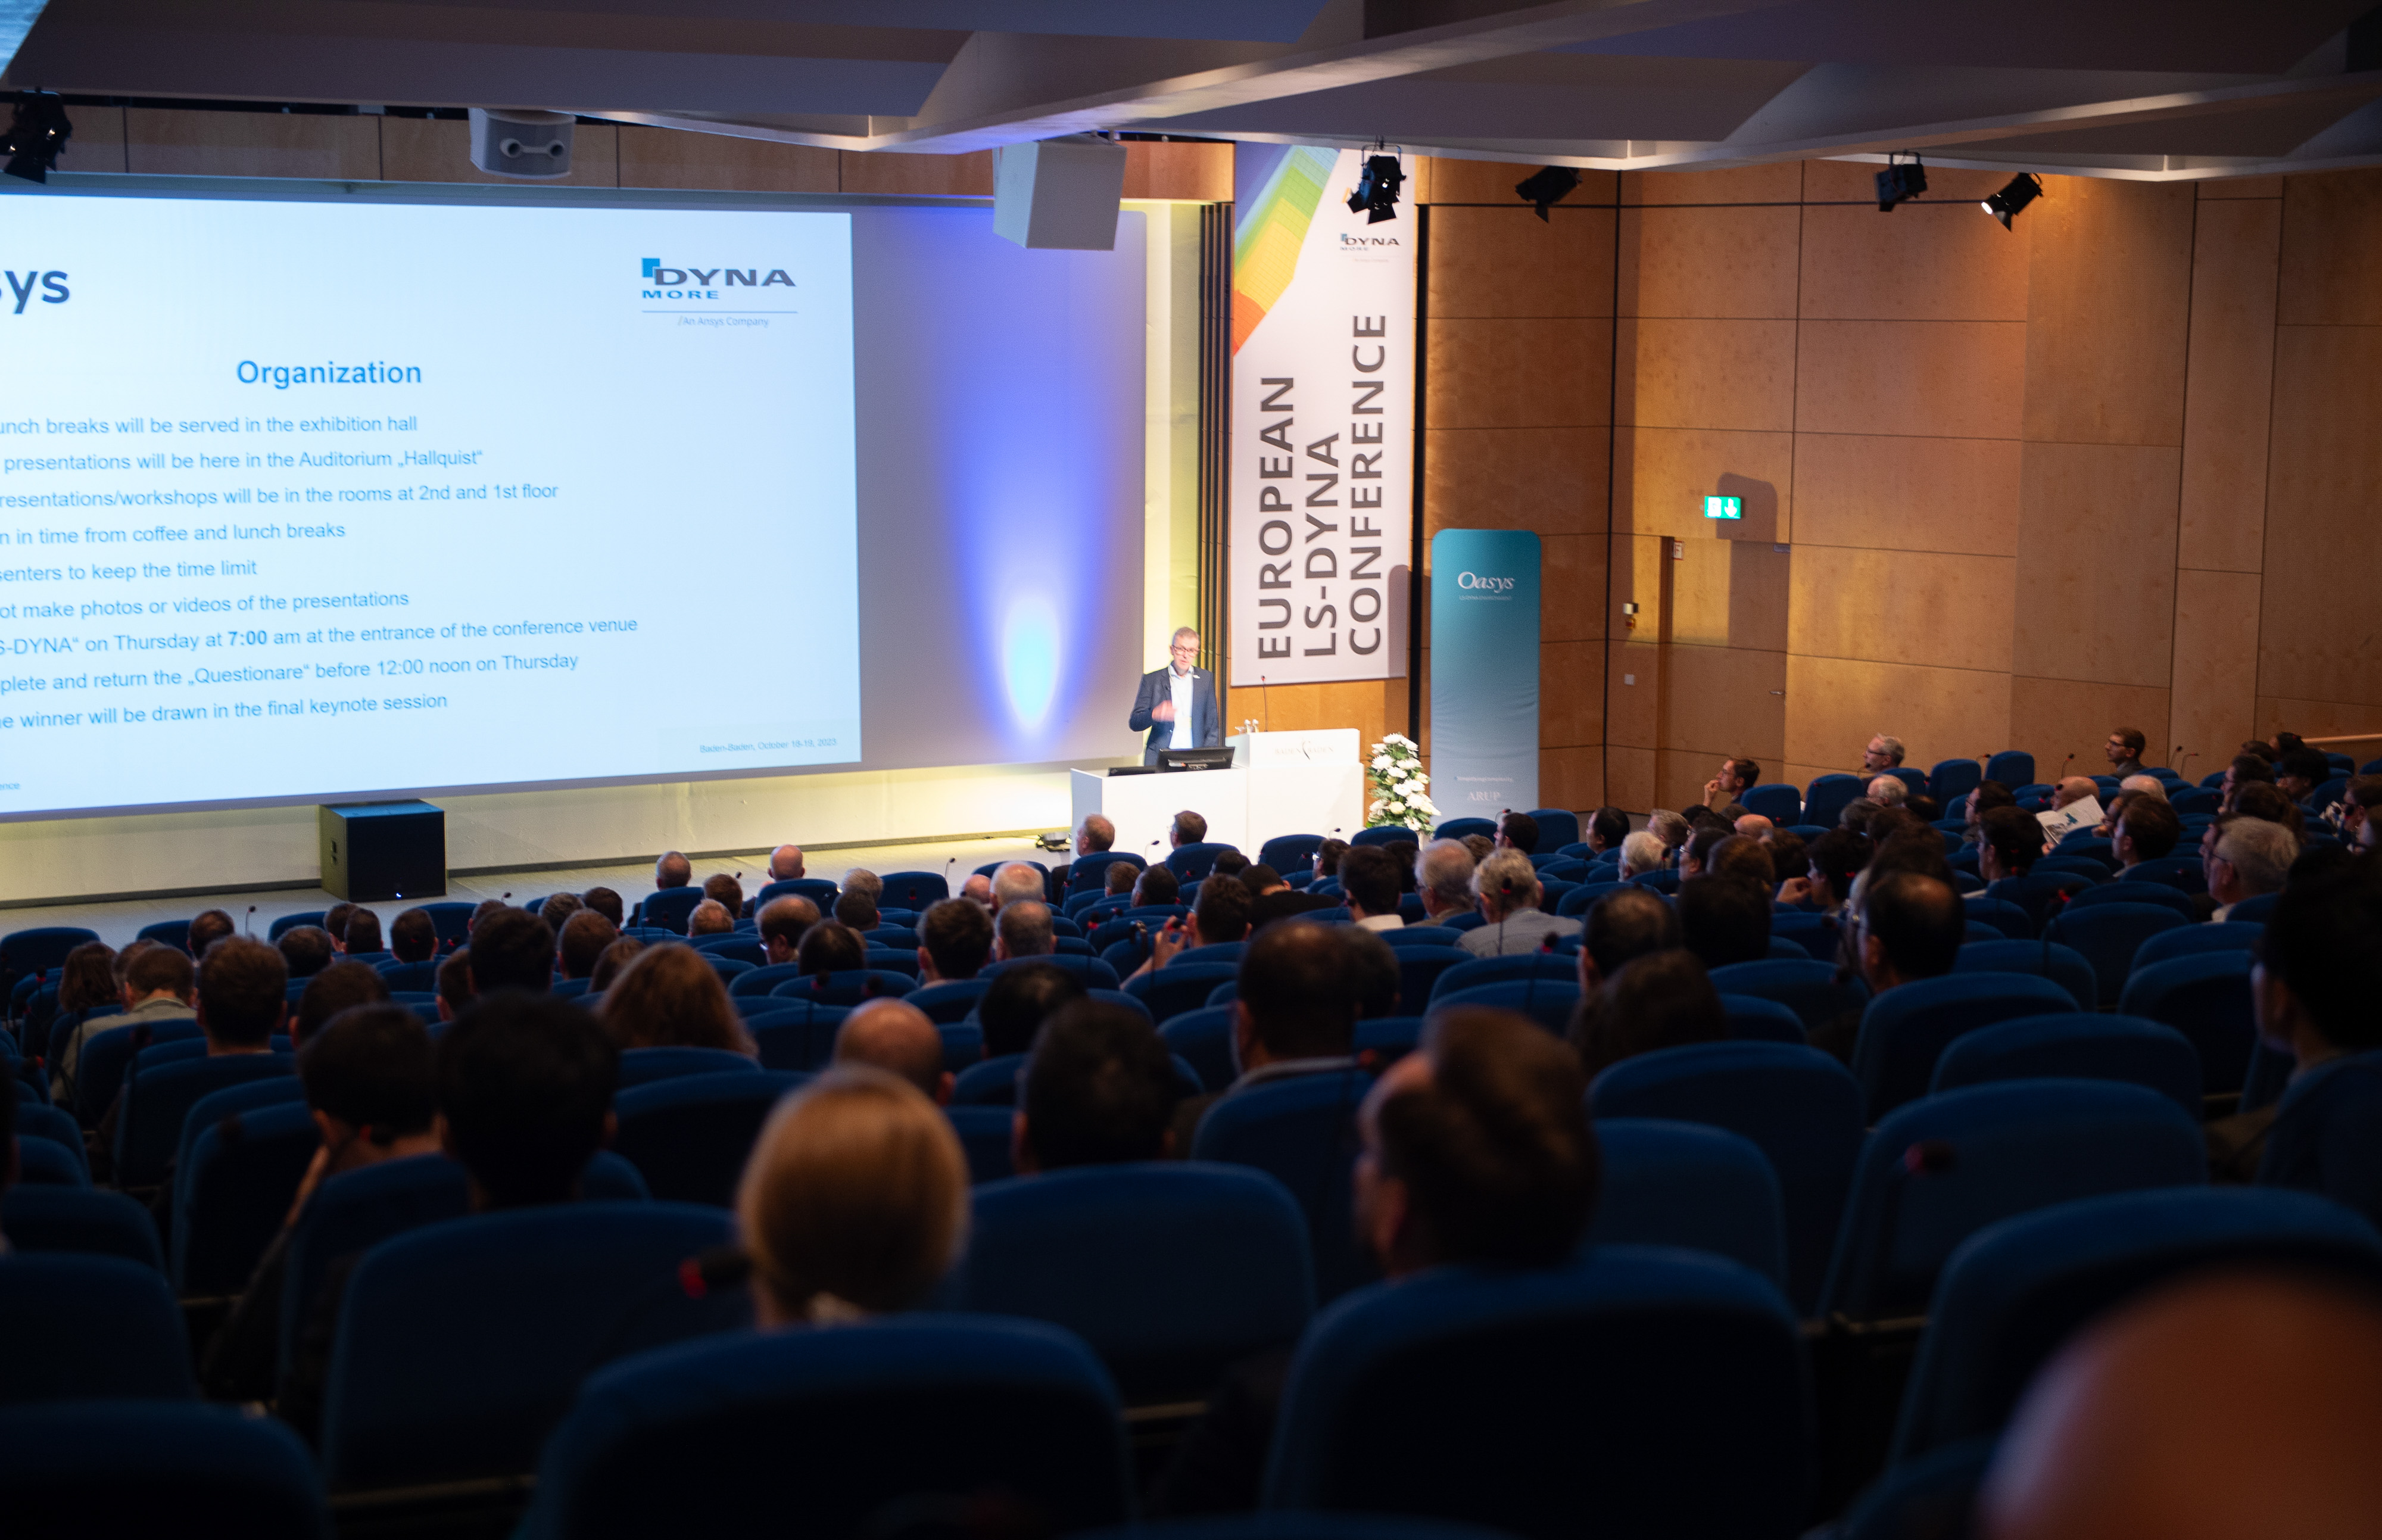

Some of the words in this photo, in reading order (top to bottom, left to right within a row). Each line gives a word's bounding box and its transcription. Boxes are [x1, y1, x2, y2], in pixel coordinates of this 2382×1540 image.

[654, 268, 796, 286] DYNA
[0, 270, 70, 314] ys
[642, 290, 719, 299] MORE
[697, 317, 724, 327] Ansys
[726, 317, 769, 328] Company
[237, 361, 422, 389] Organization
[46, 417, 110, 434] breaks
[115, 417, 144, 433] will
[150, 417, 173, 433] be
[179, 417, 239, 433] served
[245, 417, 261, 432] in
[266, 417, 294, 432] the
[300, 416, 382, 432] exhibition
[388, 416, 417, 431] hall
[4, 454, 131, 475] presentations
[136, 453, 166, 469] will
[172, 453, 194, 469] be
[200, 453, 240, 468] here
[246, 453, 261, 467] in
[267, 452, 295, 467] the
[299, 451, 392, 467] Auditorium
[223, 488, 251, 504] will
[257, 488, 279, 503] be
[285, 488, 300, 503] in
[305, 487, 333, 502] the
[339, 490, 392, 501] rooms
[397, 486, 414, 500] at
[419, 485, 450, 500] 2nd
[456, 484, 487, 500] and
[494, 484, 517, 498] 1st
[522, 484, 559, 498] floor
[1349, 316, 1385, 655] CONFERENCE
[1259, 378, 1293, 659] EUROPEAN
[17, 529, 33, 544] in
[38, 528, 79, 544] time
[84, 527, 127, 543] from
[133, 525, 188, 542] coffee
[194, 524, 227, 540] and
[233, 523, 281, 540] lunch
[287, 522, 346, 538] breaks
[1305, 434, 1339, 656] LS-DYNA
[68, 565, 86, 580] to
[92, 563, 137, 582] keep
[142, 562, 172, 578] the
[176, 561, 216, 576] time
[221, 560, 257, 575] limit
[1458, 571, 1515, 593] Oasys
[23, 601, 74, 618] make
[81, 600, 143, 620] photos
[149, 602, 168, 613] or
[173, 597, 232, 613] videos
[237, 595, 255, 611] of
[259, 594, 287, 610] the
[293, 591, 410, 613] presentations
[85, 640, 108, 651] on
[113, 633, 200, 651] Thursday
[205, 632, 223, 647] at
[227, 629, 268, 646] 7:00
[273, 632, 301, 644] am
[307, 629, 323, 643] at
[328, 627, 356, 643] the
[360, 626, 435, 641] entrance
[440, 623, 457, 638] of
[461, 622, 487, 637] the
[492, 620, 584, 636] conference
[588, 620, 638, 632] venue
[52, 673, 88, 690] and
[94, 672, 148, 688] return
[153, 669, 182, 685] the
[316, 662, 370, 678] before
[377, 659, 424, 675] 12:00
[429, 660, 471, 673] noon
[476, 659, 497, 671] on
[501, 653, 579, 671] Thursday
[20, 711, 83, 728] winner
[88, 707, 117, 724] will
[123, 707, 146, 723] be
[152, 706, 207, 721] drawn
[214, 703, 229, 718] in
[234, 702, 262, 718] the
[267, 699, 304, 716] final
[310, 697, 378, 716] keynote
[383, 693, 447, 710] session
[1467, 791, 1501, 801] ARUP
